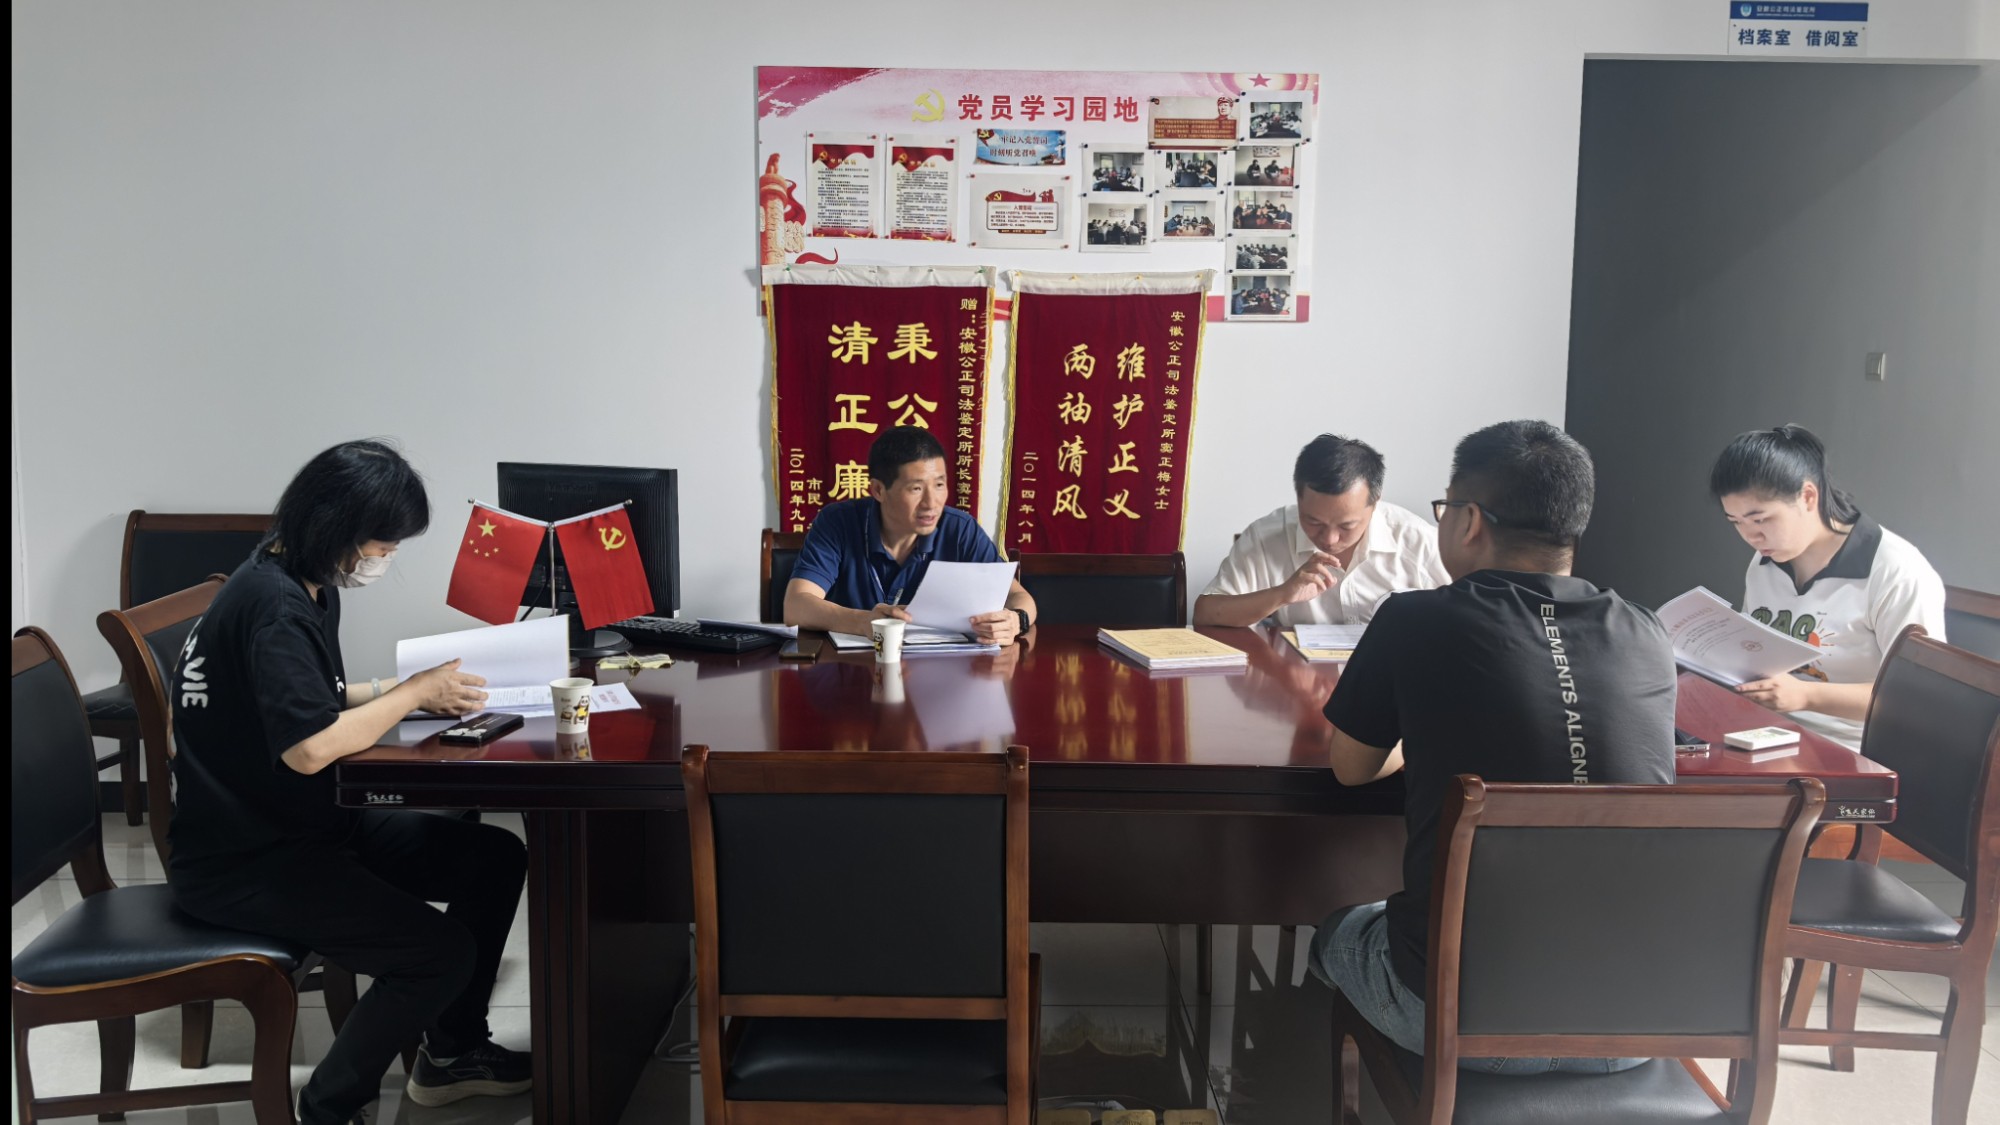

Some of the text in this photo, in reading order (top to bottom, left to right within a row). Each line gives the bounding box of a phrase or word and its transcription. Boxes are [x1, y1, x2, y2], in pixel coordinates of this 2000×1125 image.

[1738, 29, 1858, 47] 档案室 借阅室
[958, 94, 1140, 123] 党员学习园地
[990, 148, 1037, 158] 时刻听党召唤
[1001, 135, 1049, 145] 牢记入党誓词
[1052, 343, 1096, 519] 两袖清风
[1103, 342, 1146, 519] 维护正义
[1540, 603, 1578, 705] ELEMENTS
